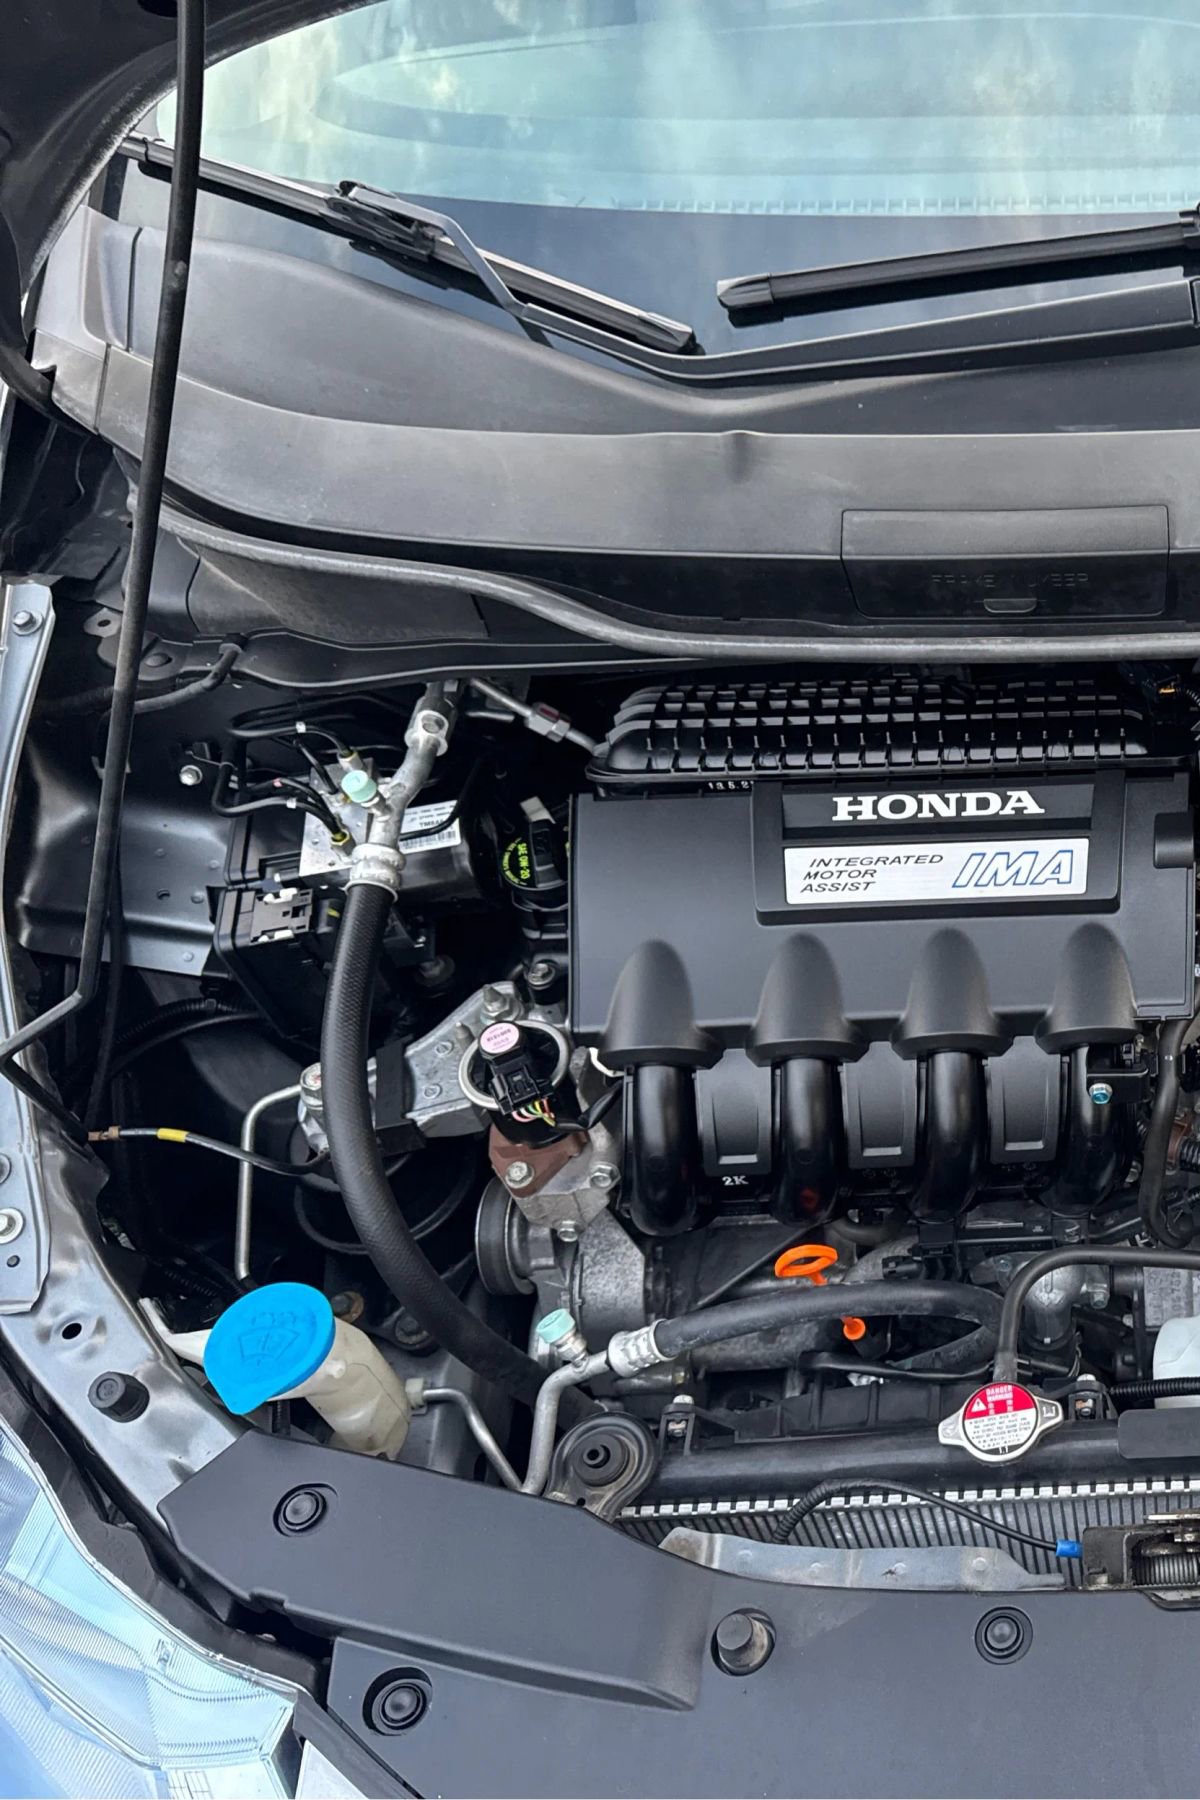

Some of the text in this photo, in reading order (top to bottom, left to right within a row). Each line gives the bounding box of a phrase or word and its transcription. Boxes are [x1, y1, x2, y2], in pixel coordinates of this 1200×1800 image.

[831, 790, 1045, 821] HONDA
[517, 842, 528, 855] SAE
[802, 868, 877, 881] MOTOR
[808, 849, 1074, 888] INTEGRATED IMA
[799, 881, 876, 894] ASSIST
[722, 1175, 749, 1186] 2K
